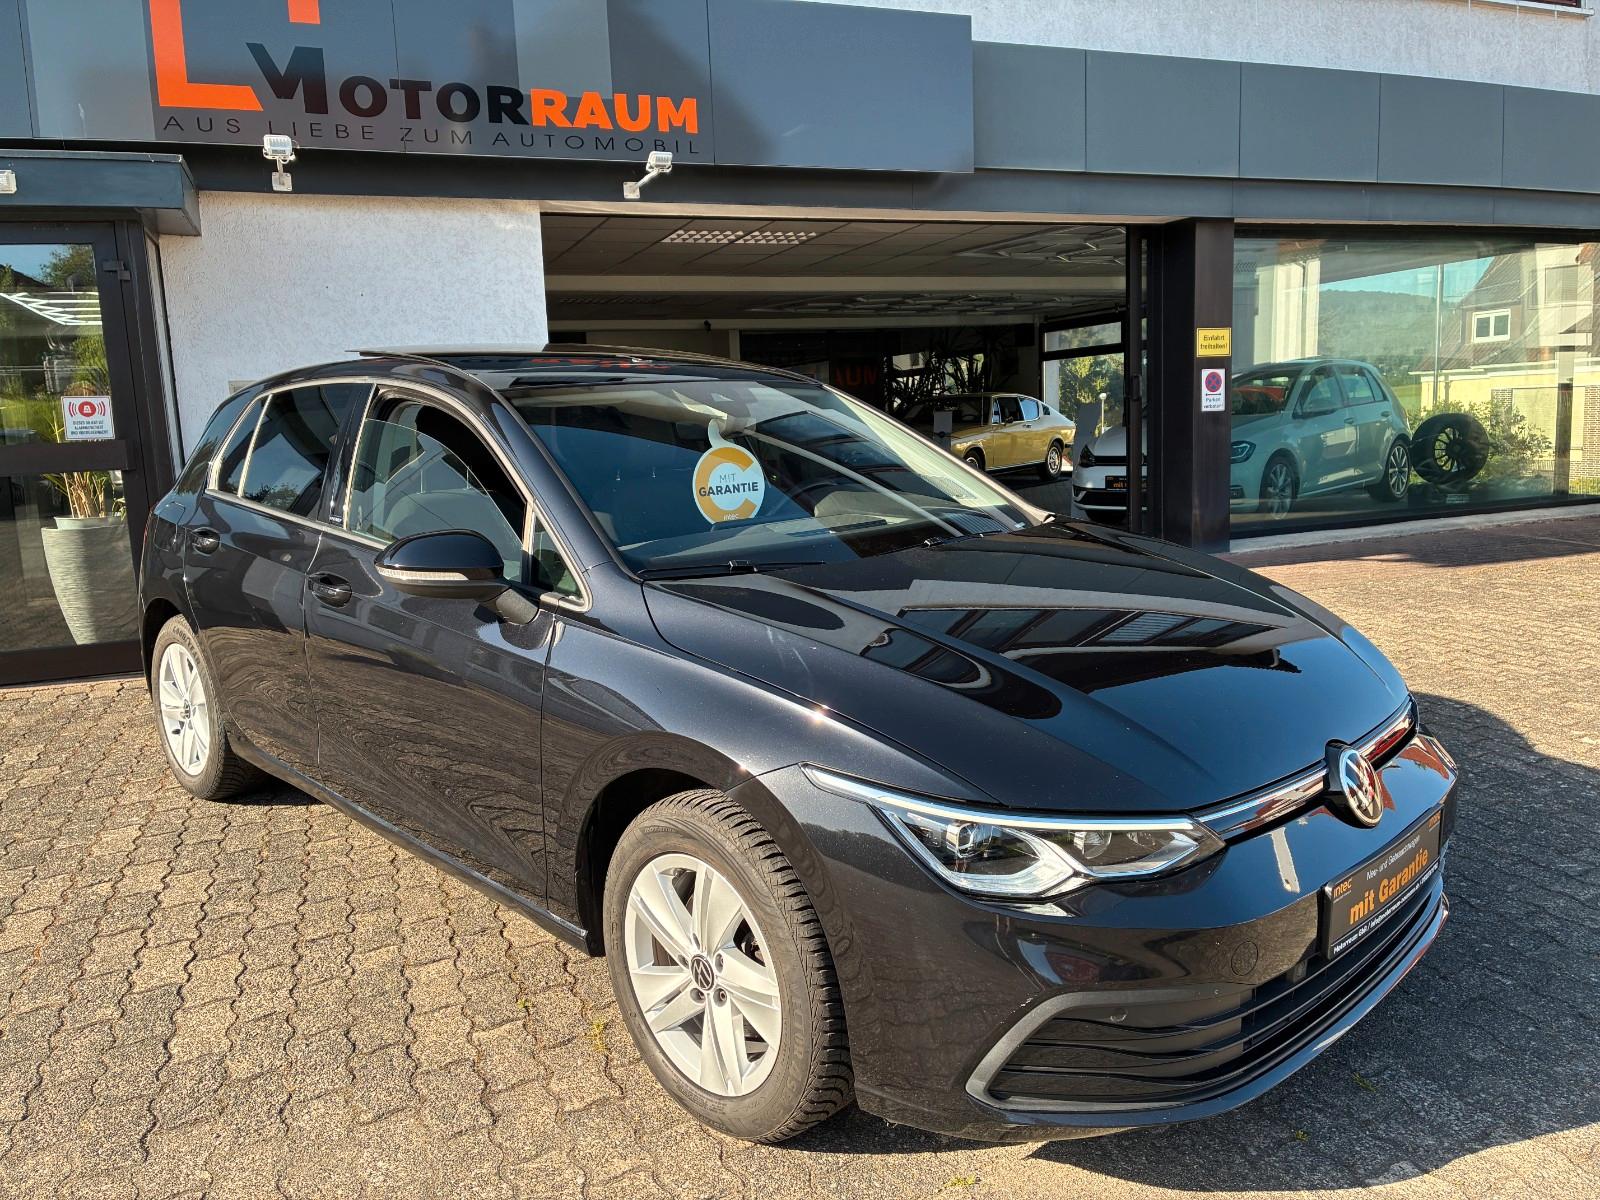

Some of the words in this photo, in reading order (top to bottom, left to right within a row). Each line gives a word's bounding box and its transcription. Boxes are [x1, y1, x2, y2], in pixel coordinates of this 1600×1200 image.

[163, 115, 241, 134] AUS
[268, 120, 376, 140] LIEBE
[400, 126, 474, 145] ZUM
[492, 131, 700, 155] AUTOMOBIL
[719, 473, 737, 482] MIT
[698, 482, 759, 497] GARANTIE
[1333, 878, 1353, 899] intec
[1350, 889, 1375, 925] mit
[1379, 847, 1429, 903] Garantie
